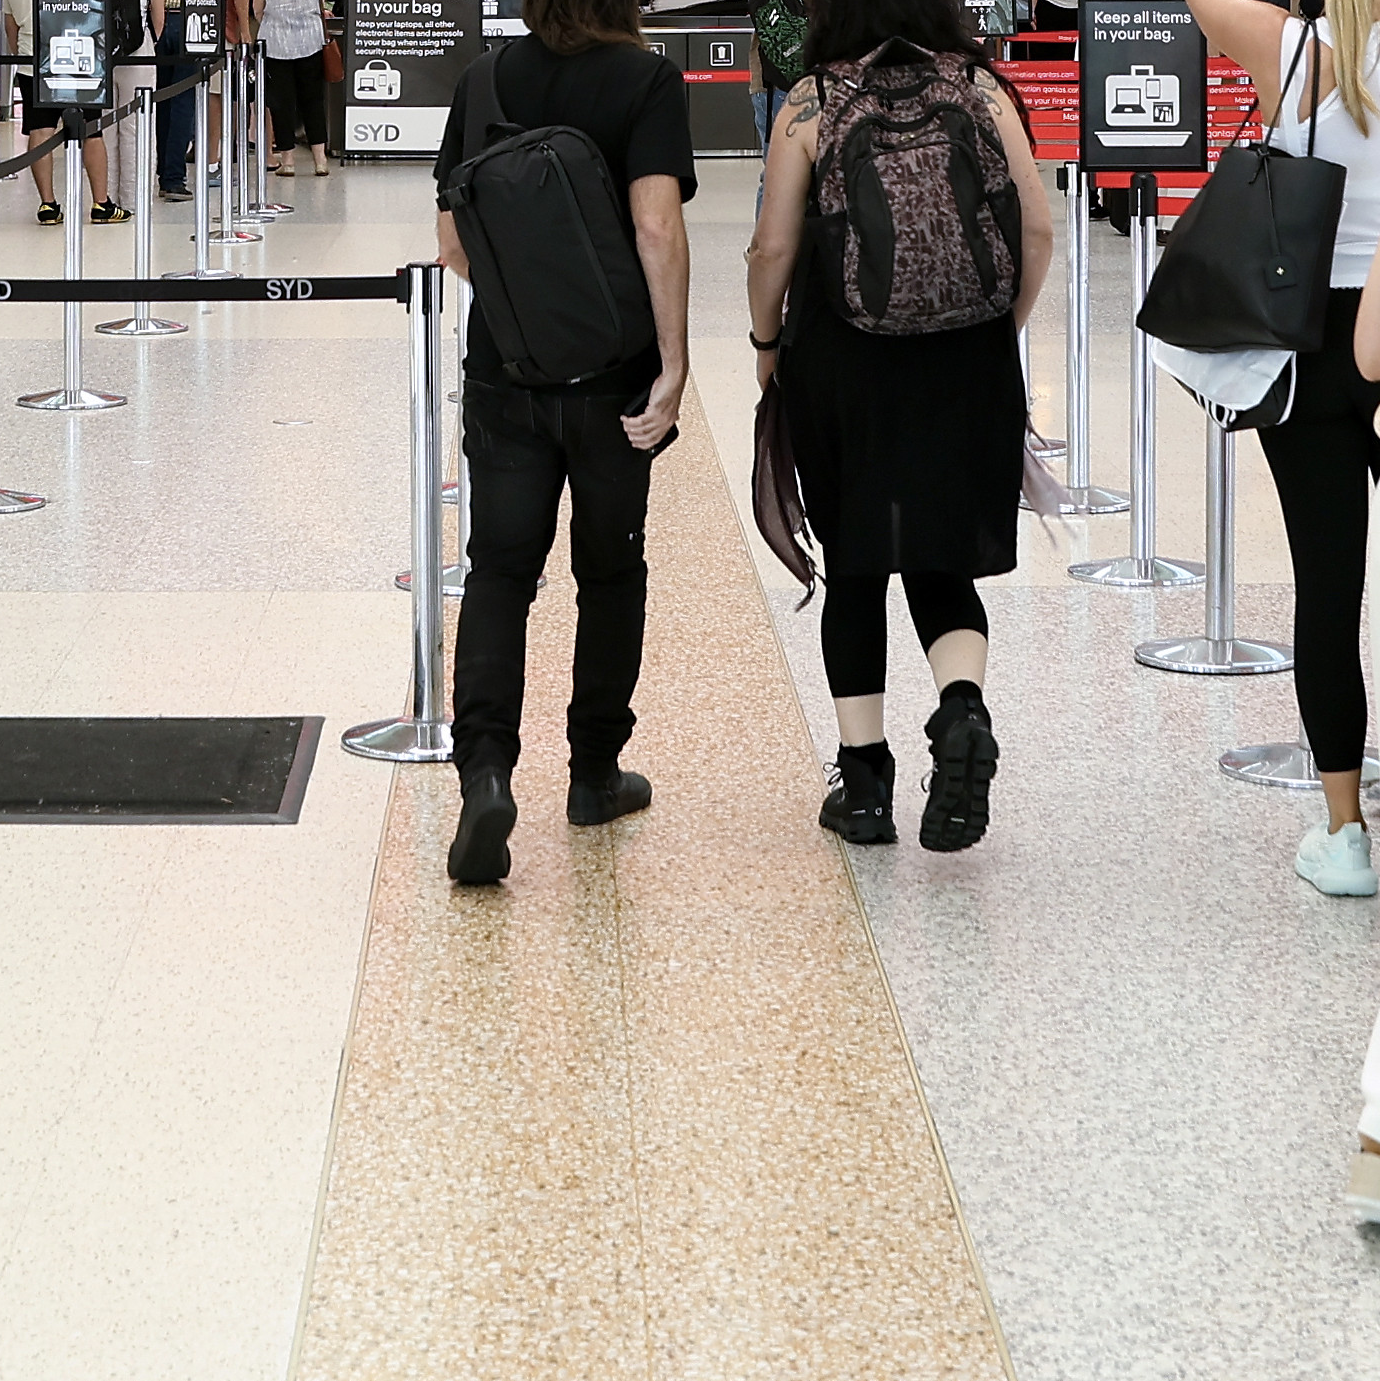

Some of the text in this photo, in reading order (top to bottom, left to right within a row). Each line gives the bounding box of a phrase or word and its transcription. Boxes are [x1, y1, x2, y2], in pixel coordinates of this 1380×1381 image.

[43, 1, 91, 13] in your bag.
[357, 0, 441, 17] in your bag
[356, 20, 375, 28] Keep
[394, 21, 424, 29] laptops,
[1095, 11, 1191, 26] Keep all items
[1095, 27, 1174, 43] in your bag.
[381, 39, 396, 47] bag
[419, 39, 439, 47] using
[355, 48, 444, 56] security screening point
[354, 124, 399, 141] SYD
[267, 279, 315, 301] SYD
